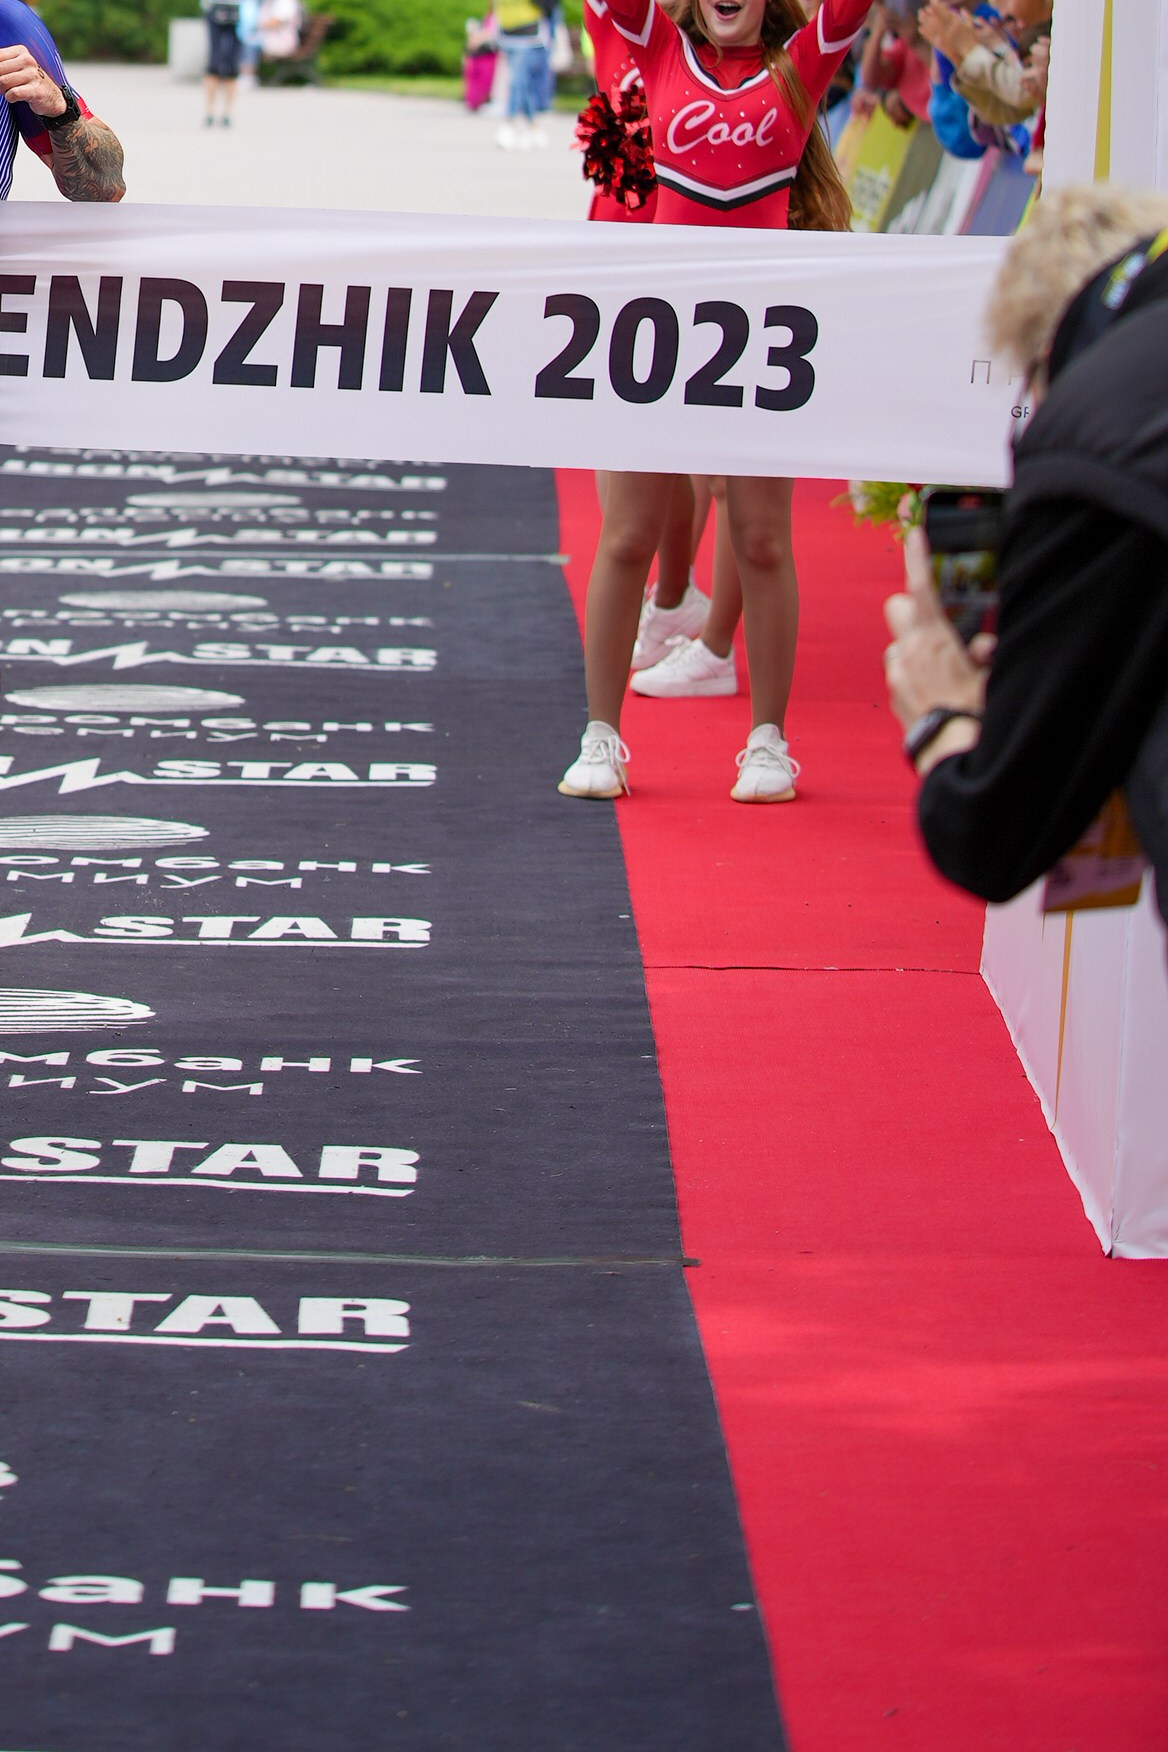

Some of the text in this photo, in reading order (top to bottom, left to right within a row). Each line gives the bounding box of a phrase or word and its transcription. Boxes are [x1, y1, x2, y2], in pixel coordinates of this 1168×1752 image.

[667, 99, 777, 154] Cool
[534, 293, 820, 411] 2023
[193, 641, 438, 667] STAR
[153, 760, 437, 781] STAR
[93, 916, 432, 941] STAR
[1, 1136, 421, 1183] STAR
